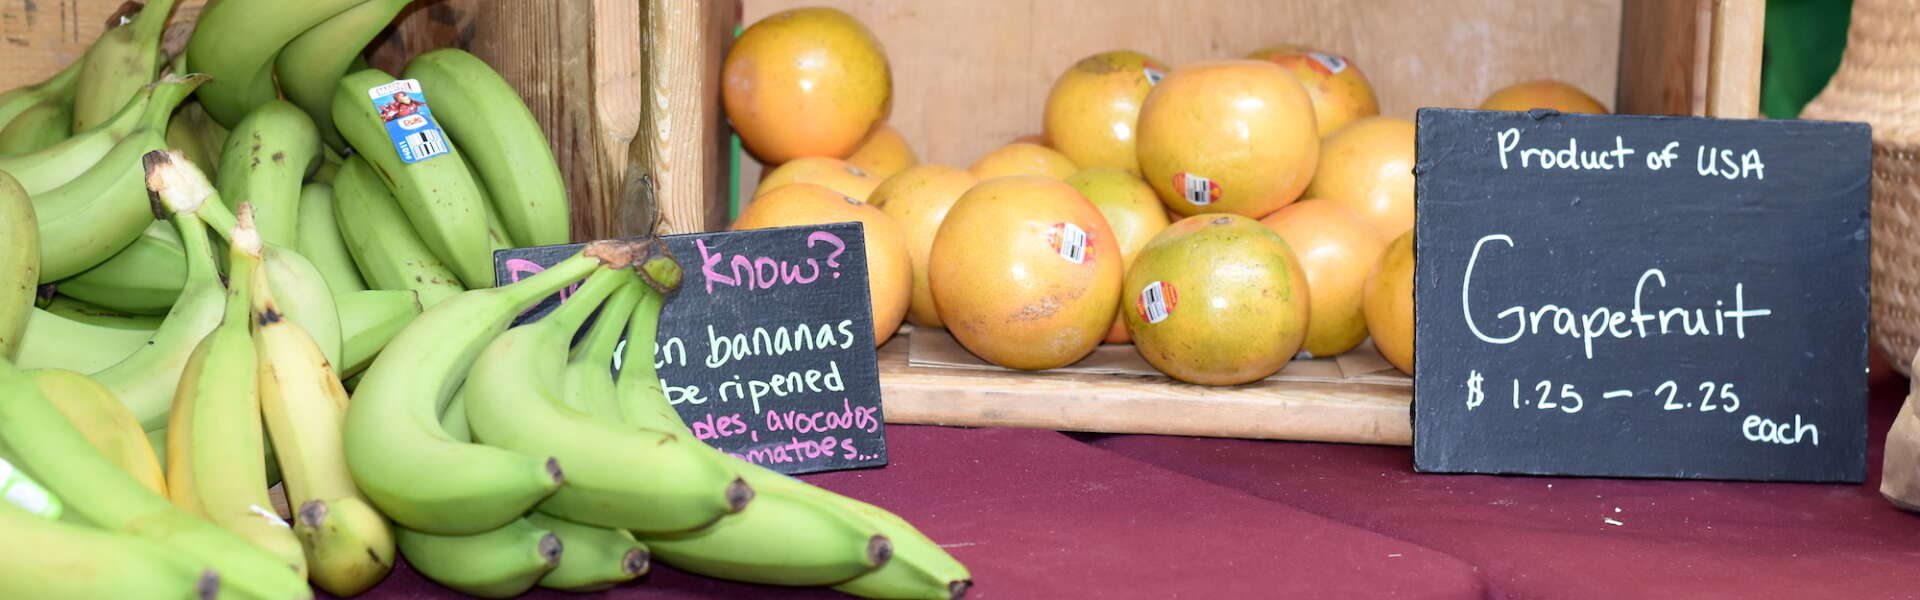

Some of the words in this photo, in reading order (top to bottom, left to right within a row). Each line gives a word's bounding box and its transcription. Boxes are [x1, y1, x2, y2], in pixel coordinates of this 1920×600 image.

[1498, 128, 1634, 170] Product
[1647, 142, 1678, 170] of
[1698, 145, 1765, 179] USA
[1463, 234, 1771, 359] Grapefruit
[705, 319, 855, 368] bananas
[660, 379, 708, 405] be
[719, 361, 845, 414] ripened
[1466, 370, 1485, 410] $
[1512, 379, 1584, 413] 1.25
[1655, 380, 1740, 413] 2.25
[766, 397, 879, 434] avocados
[1742, 415, 1818, 446] each
